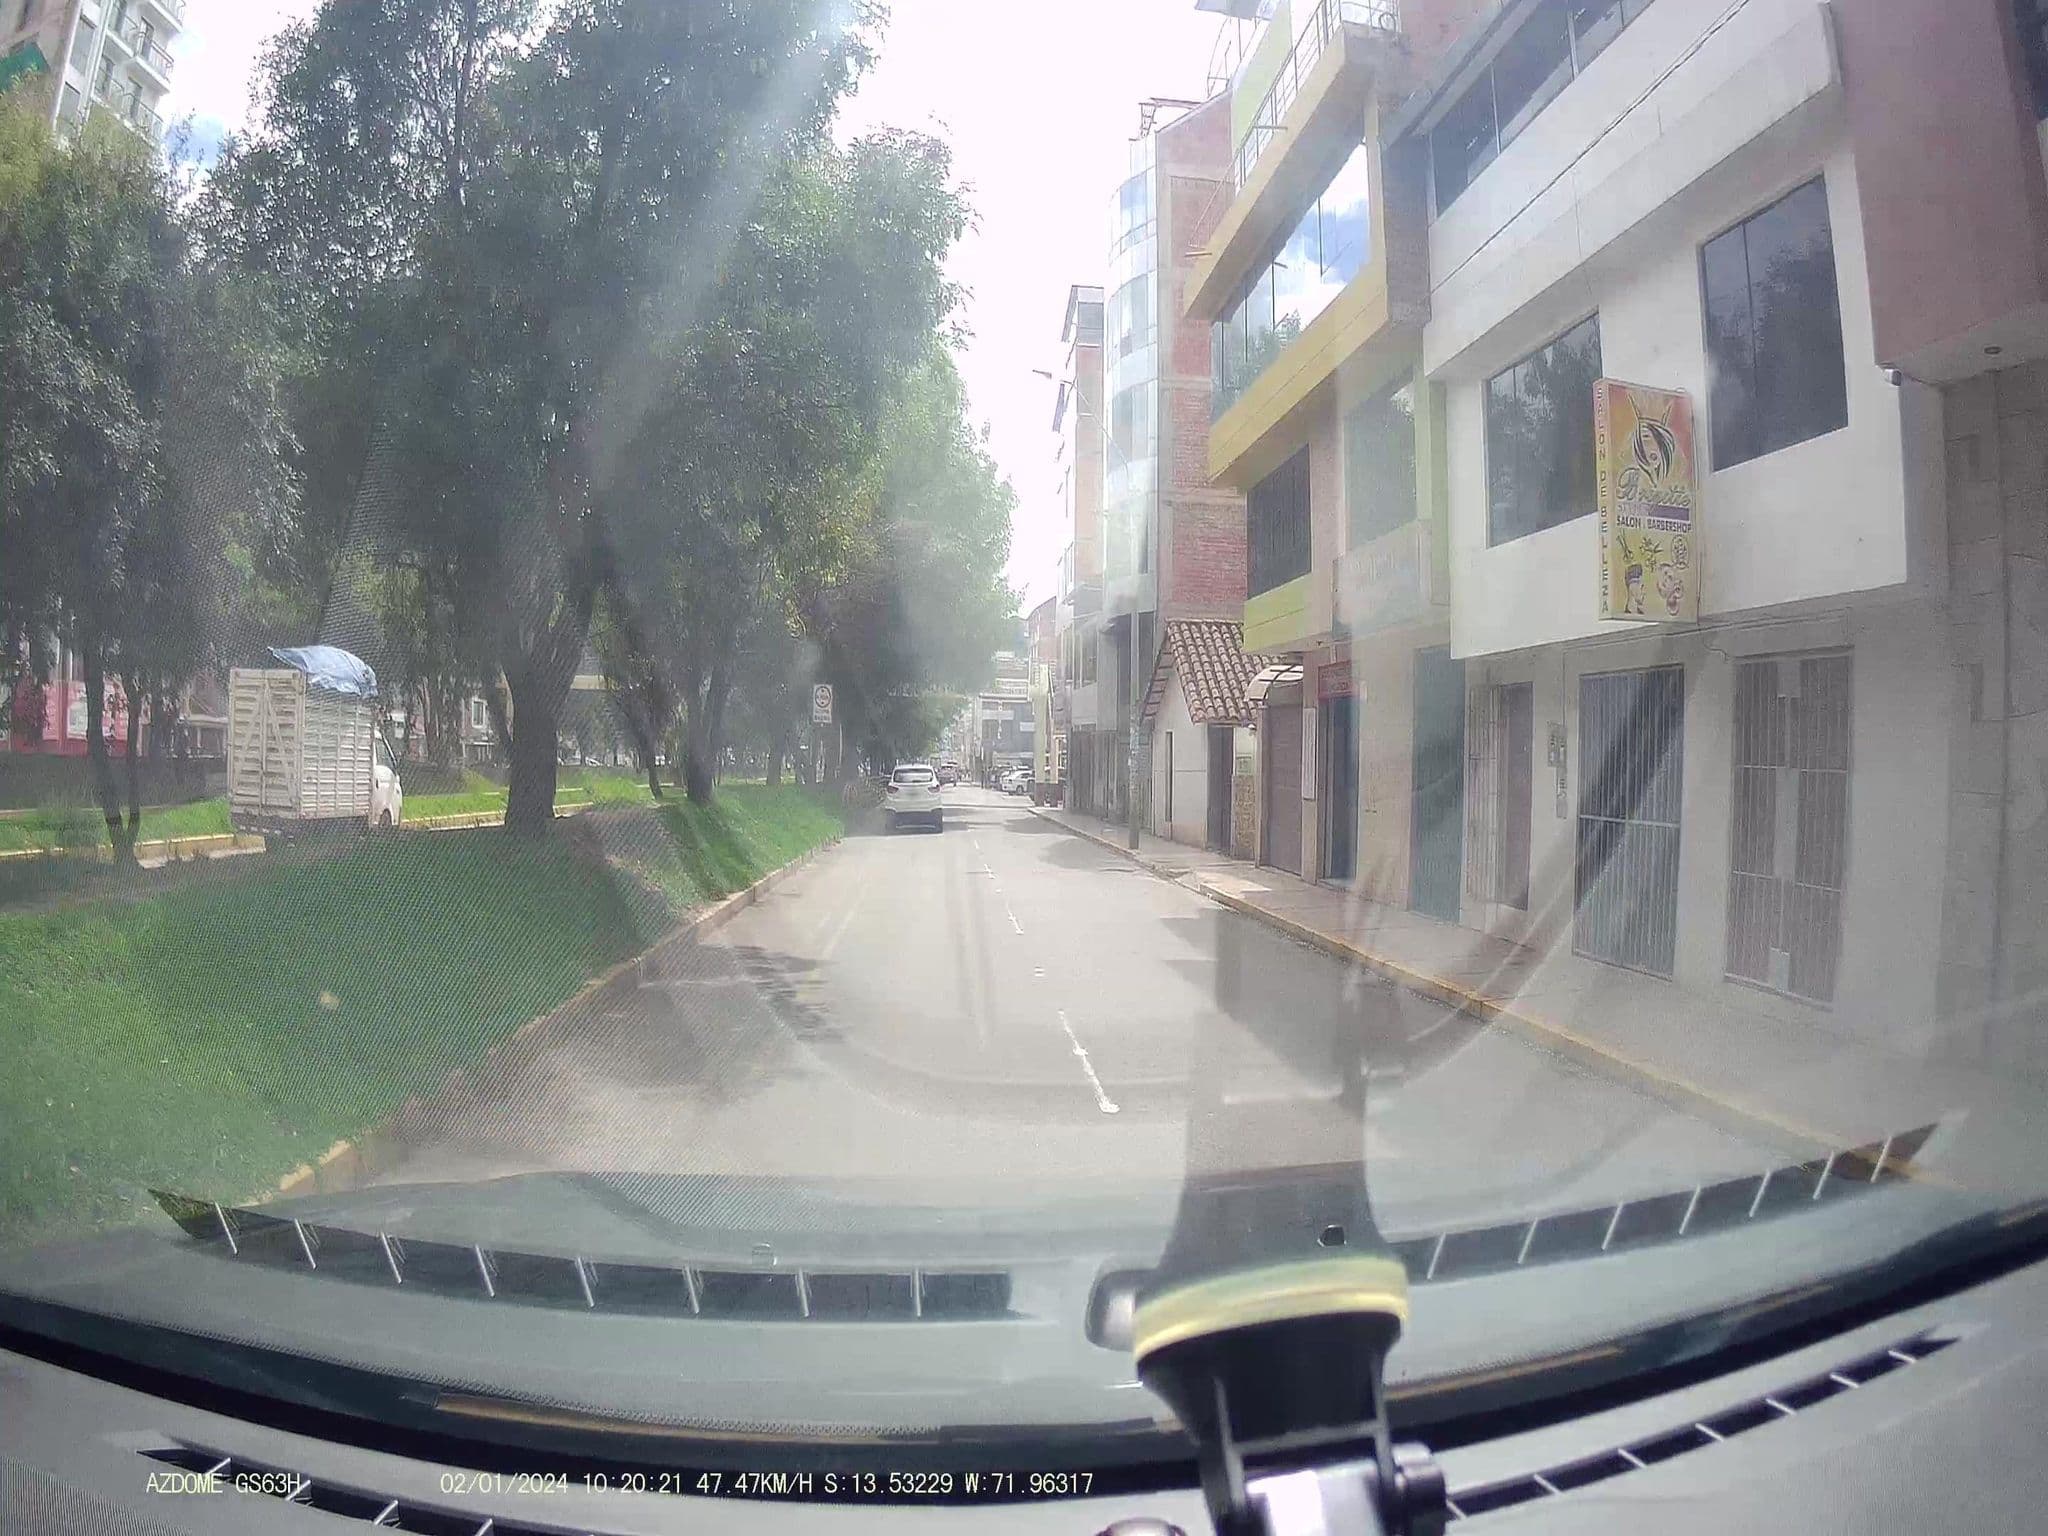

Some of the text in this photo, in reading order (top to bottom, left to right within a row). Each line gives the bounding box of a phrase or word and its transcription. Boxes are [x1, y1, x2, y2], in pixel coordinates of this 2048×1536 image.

[1597, 387, 1609, 613] SALON DE BELLEZA
[1616, 515, 1692, 533] SALON BARBERSHOP
